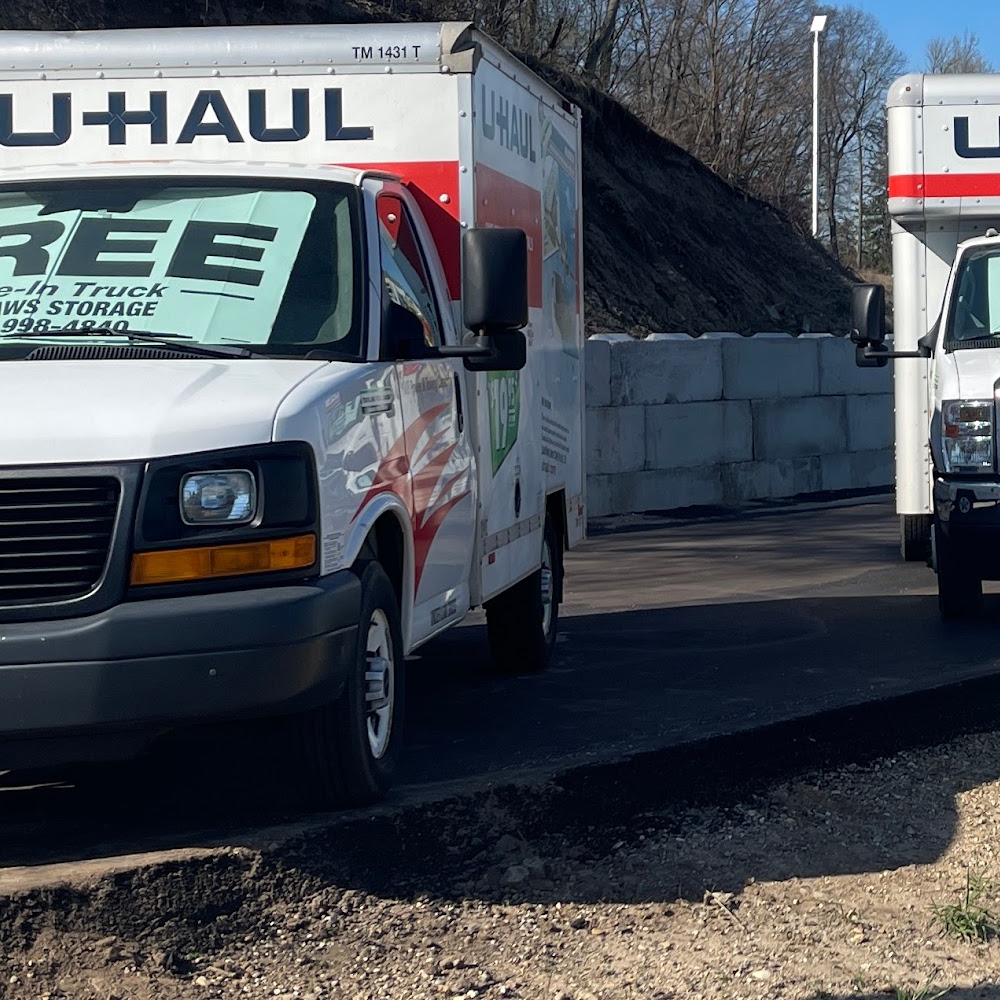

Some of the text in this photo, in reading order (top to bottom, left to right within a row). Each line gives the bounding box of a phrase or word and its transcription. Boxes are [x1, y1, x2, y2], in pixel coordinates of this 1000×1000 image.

[352, 45, 421, 59] TM 1431 T
[0, 87, 374, 147] U-HAUL
[481, 83, 536, 163] U-HAUL
[73, 282, 169, 298] Truck
[46, 300, 158, 317] STORAGE
